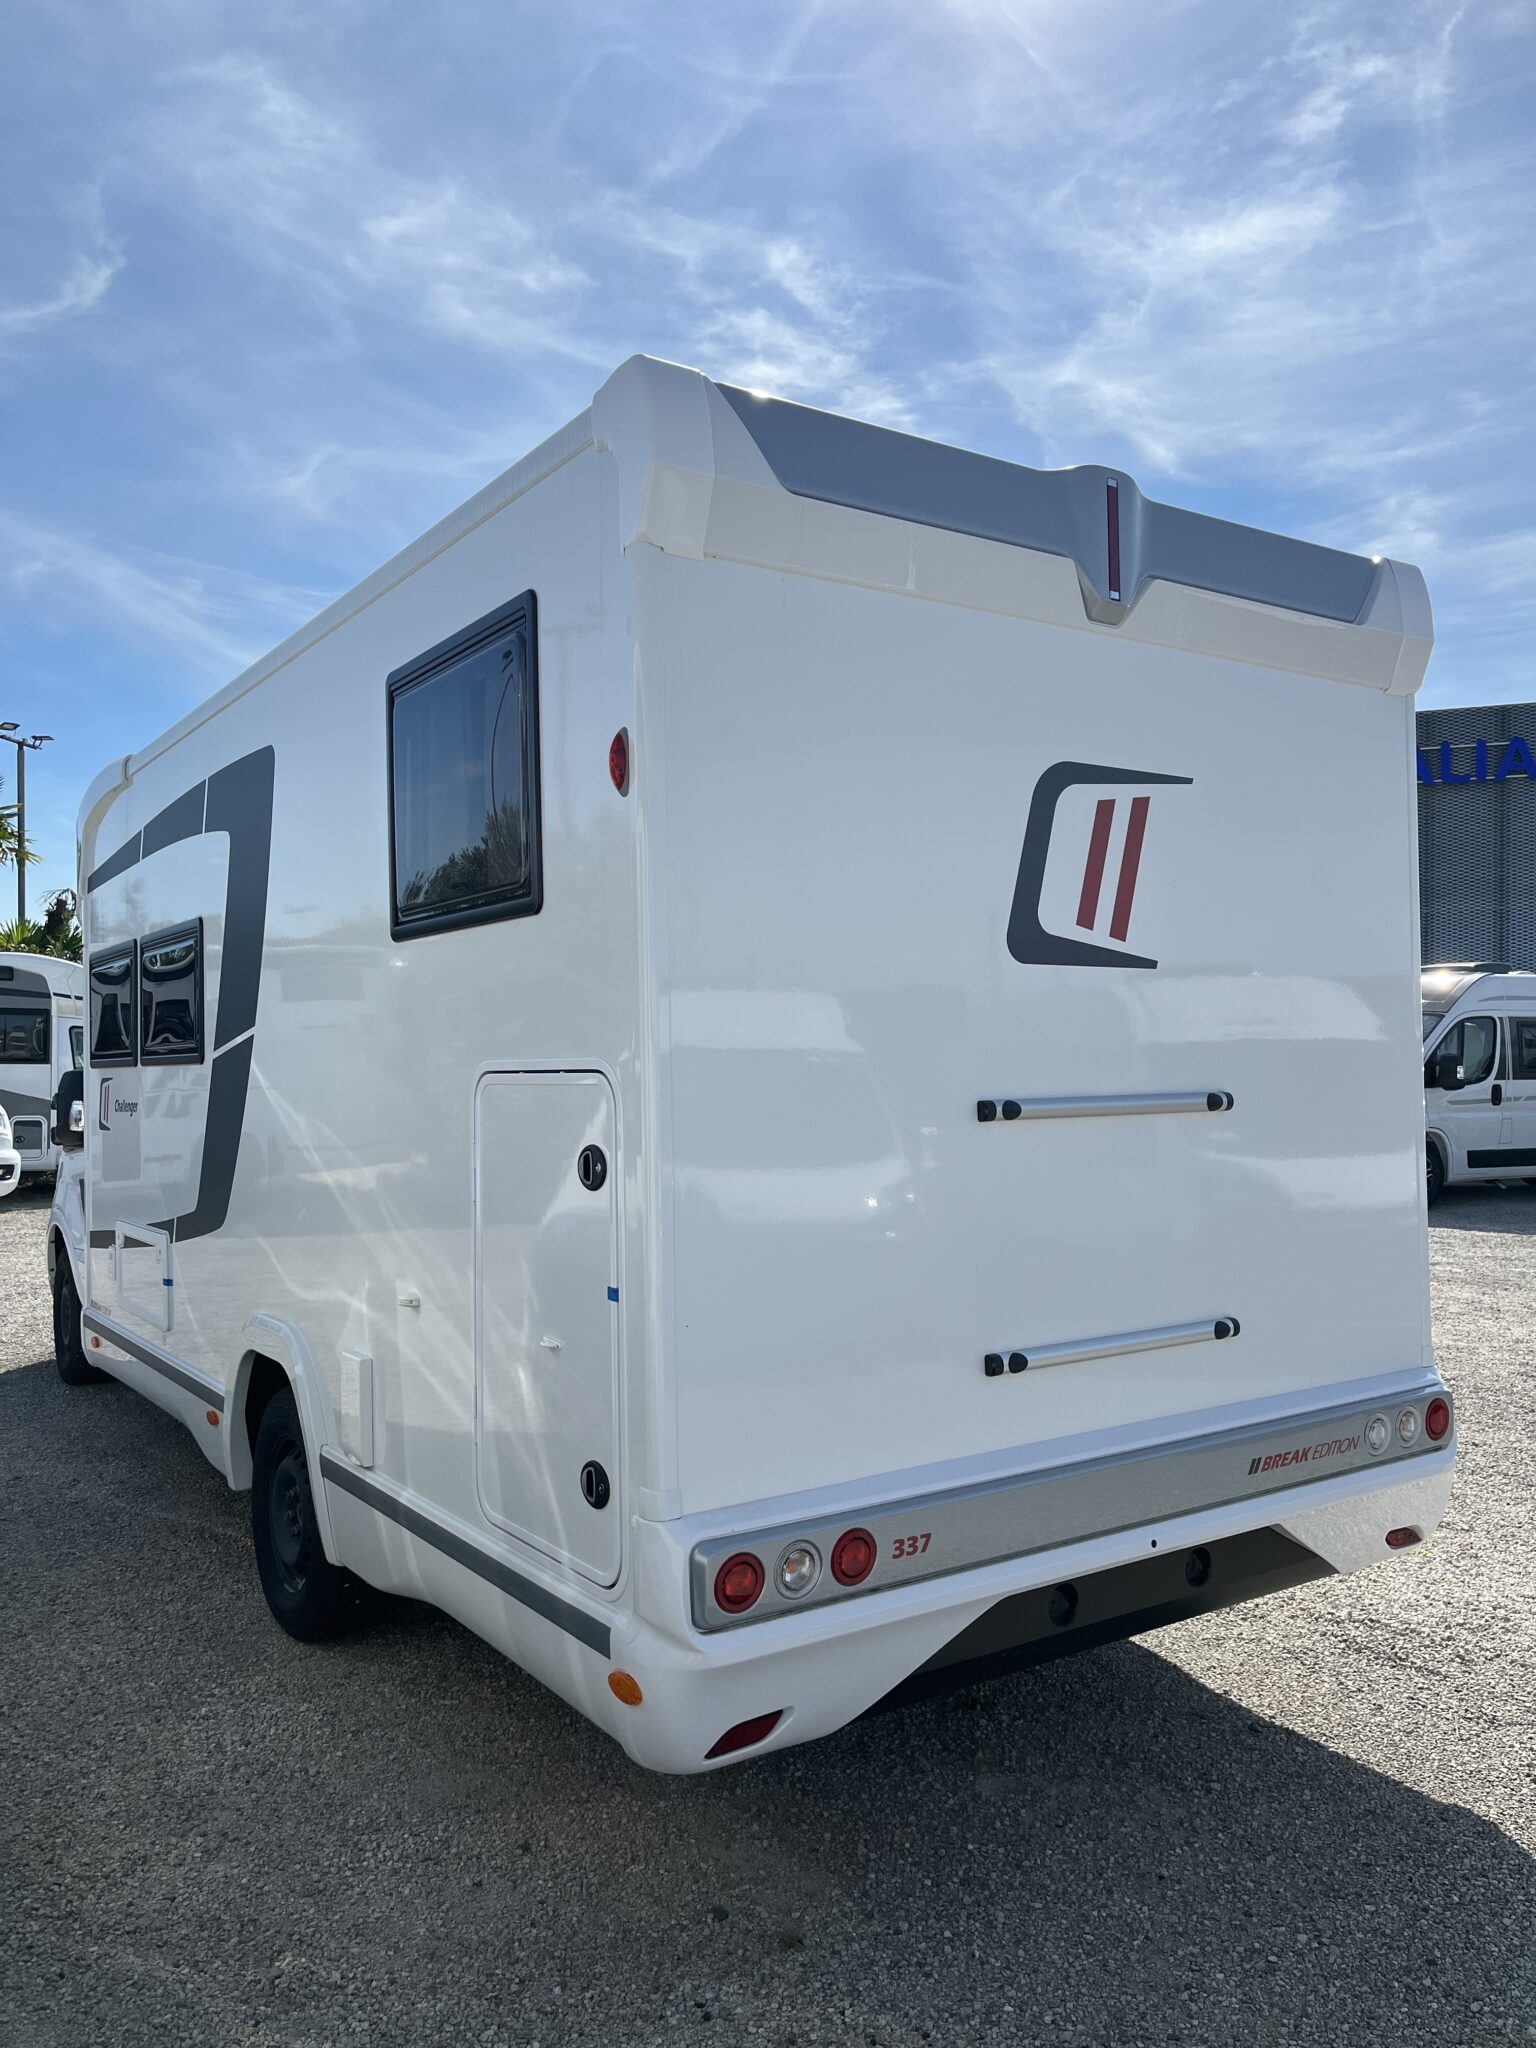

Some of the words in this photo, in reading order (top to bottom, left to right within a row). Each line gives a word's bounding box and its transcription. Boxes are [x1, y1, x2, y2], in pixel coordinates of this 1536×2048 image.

[115, 1099, 138, 1117] Challenger
[1260, 1447, 1311, 1472] BREAK
[1311, 1435, 1360, 1460] EDITION
[892, 1532, 931, 1560] 337
